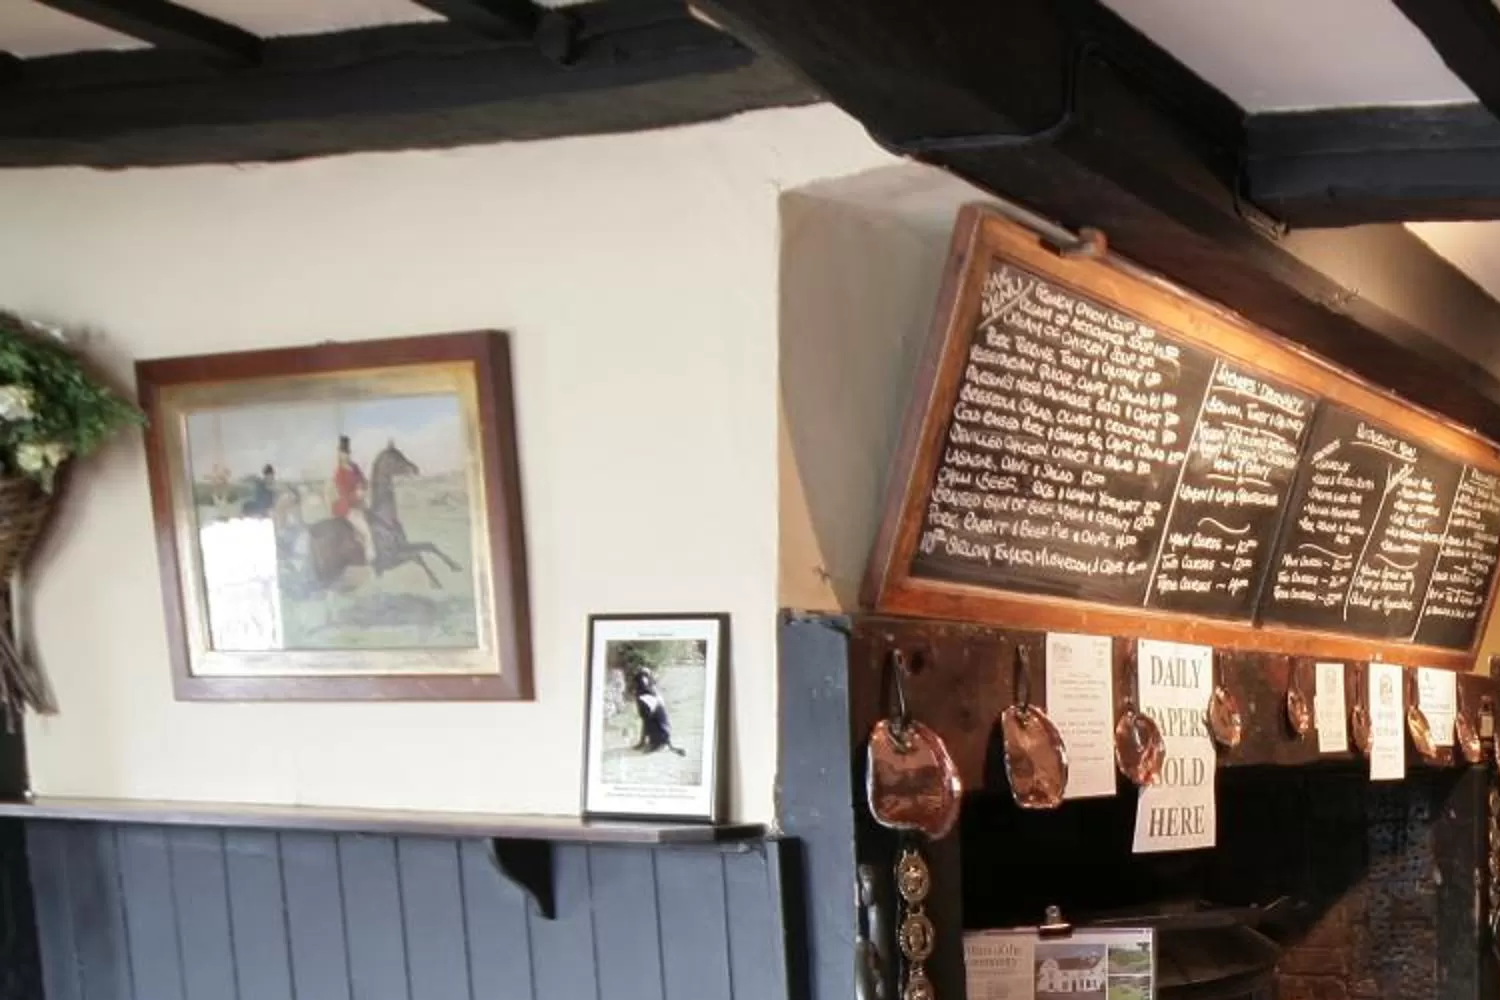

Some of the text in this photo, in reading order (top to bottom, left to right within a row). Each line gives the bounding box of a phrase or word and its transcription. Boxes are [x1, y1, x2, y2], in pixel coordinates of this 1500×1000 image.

[1150, 655, 1202, 689] DAILY
[1153, 757, 1205, 787] OLD
[1149, 805, 1205, 838] HERE
